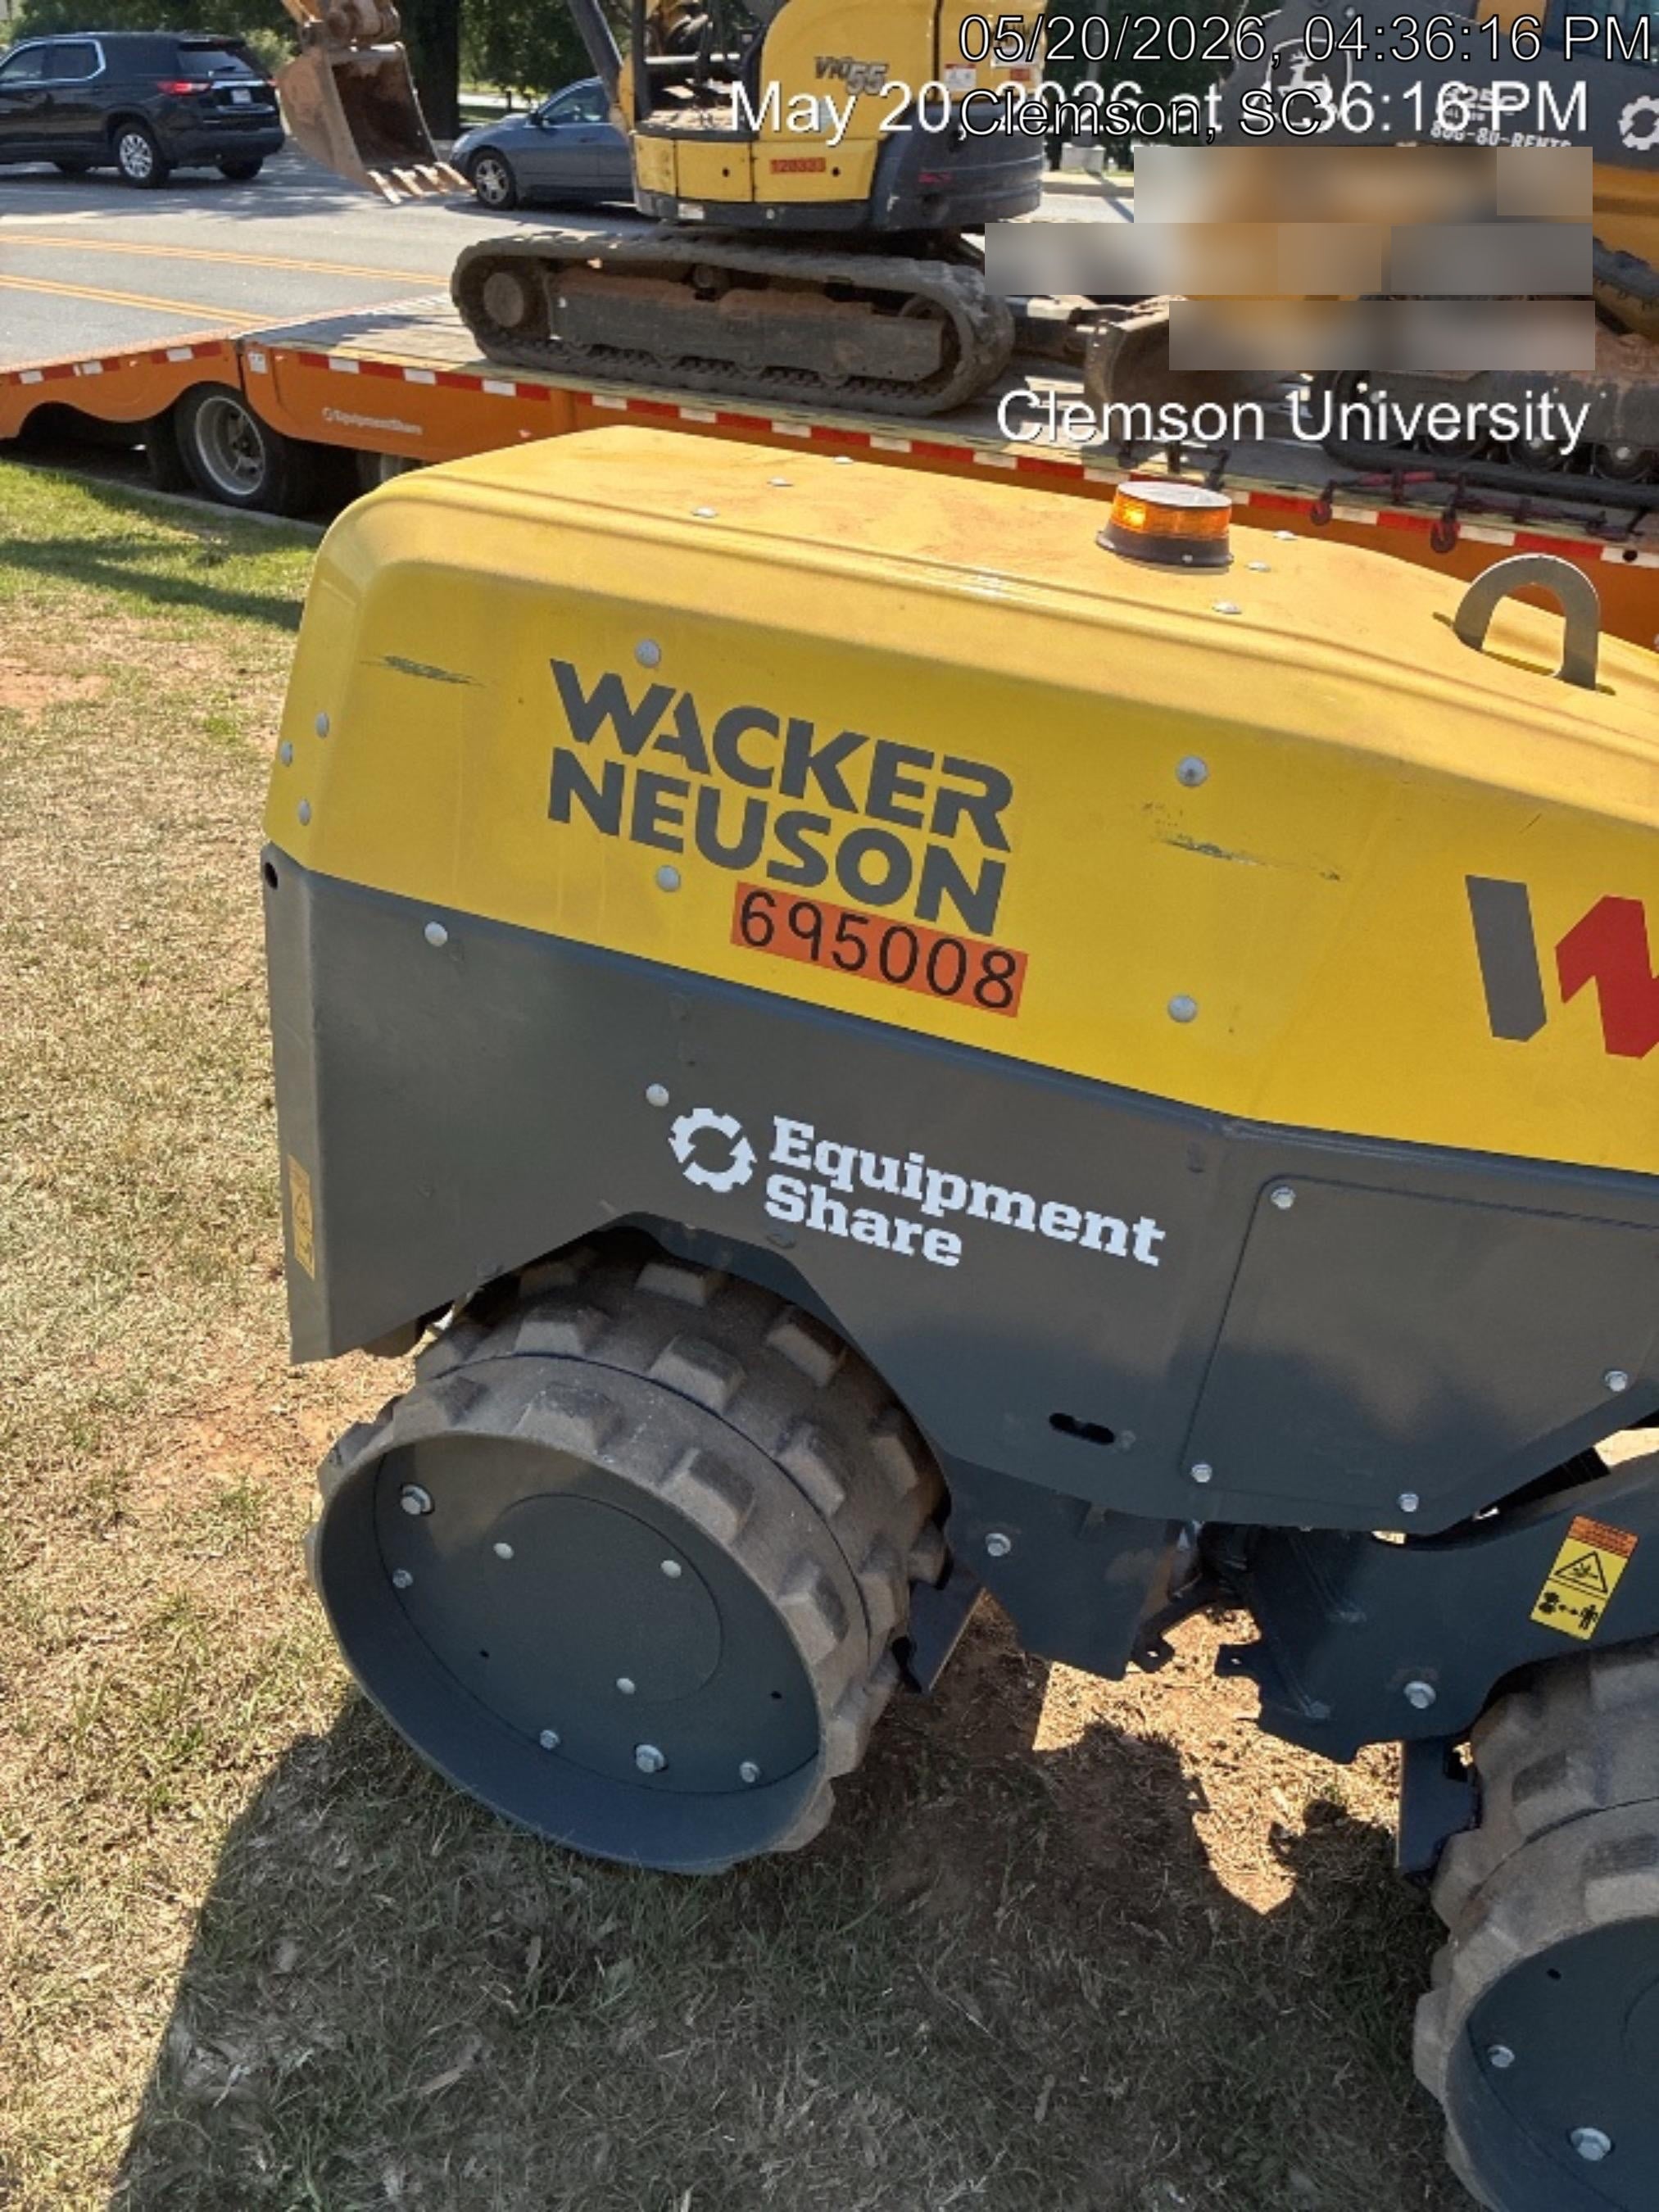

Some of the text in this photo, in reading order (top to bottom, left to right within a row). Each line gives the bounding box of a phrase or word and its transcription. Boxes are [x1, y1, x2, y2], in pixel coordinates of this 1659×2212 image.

[551, 659, 1013, 852] WACKER
[548, 746, 1006, 937] NEUSON
[739, 890, 1018, 1010] 695008
[764, 1174, 963, 1267] Share
[768, 1115, 1166, 1267] Equipment
